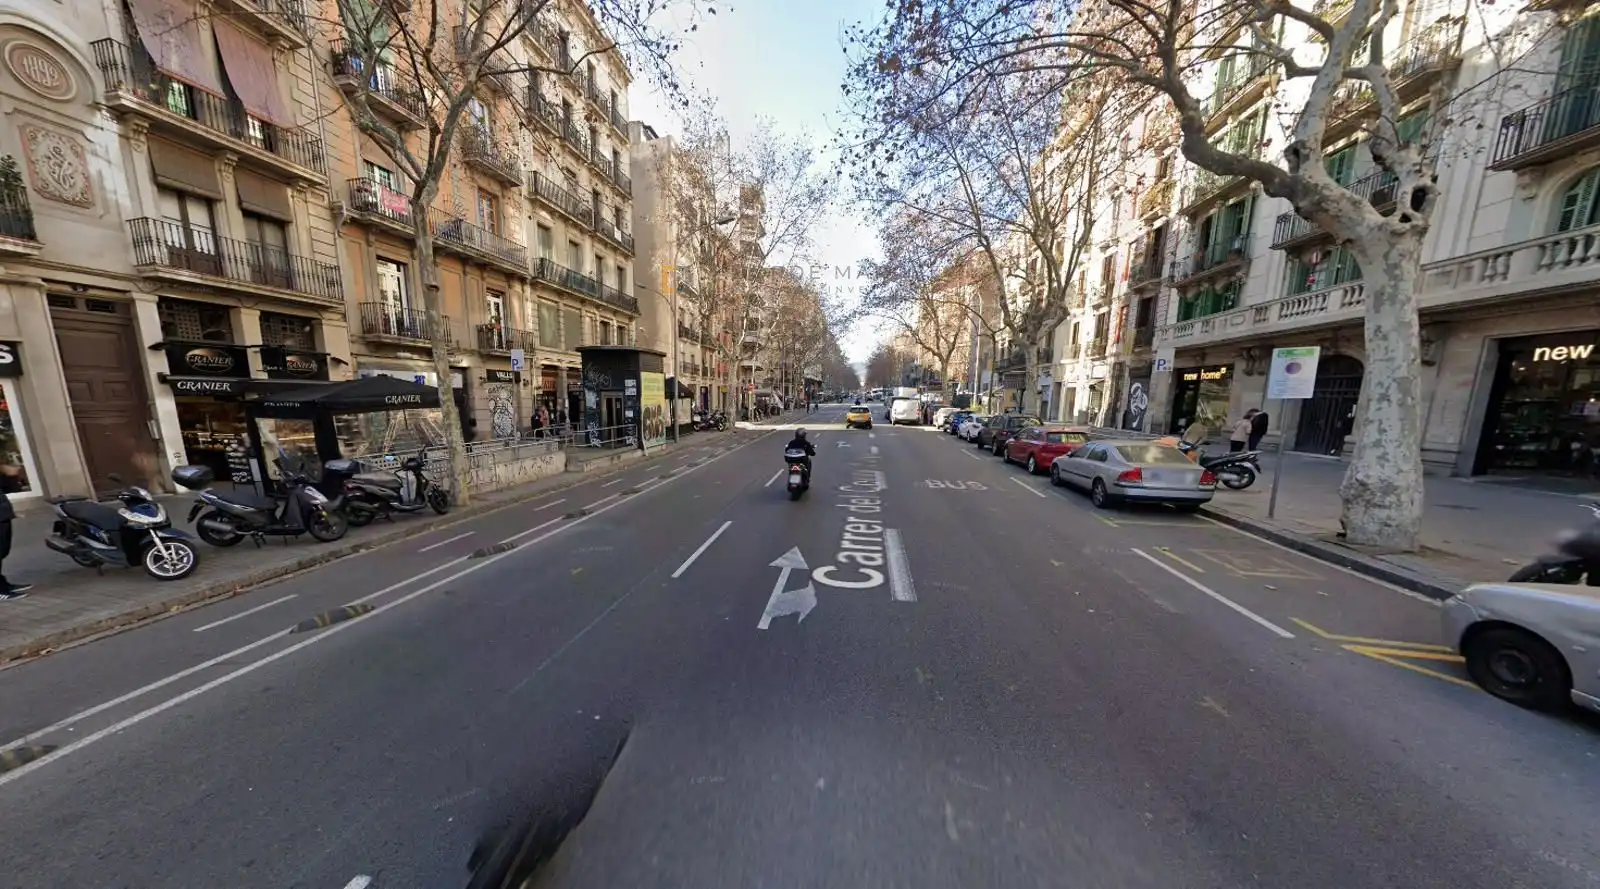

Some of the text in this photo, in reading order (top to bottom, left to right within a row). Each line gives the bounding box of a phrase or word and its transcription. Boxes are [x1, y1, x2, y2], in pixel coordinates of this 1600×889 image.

[1532, 344, 1595, 362] new
[186, 355, 233, 365] GRANIER
[286, 359, 317, 371] RANIER
[1157, 358, 1167, 371] P
[1183, 372, 1199, 381] new
[1200, 368, 1221, 381] home
[176, 380, 232, 393] GRANIER
[385, 394, 421, 405] GRANIER
[924, 477, 989, 492] BUS
[835, 494, 882, 514] del
[811, 515, 885, 589] Carrer
